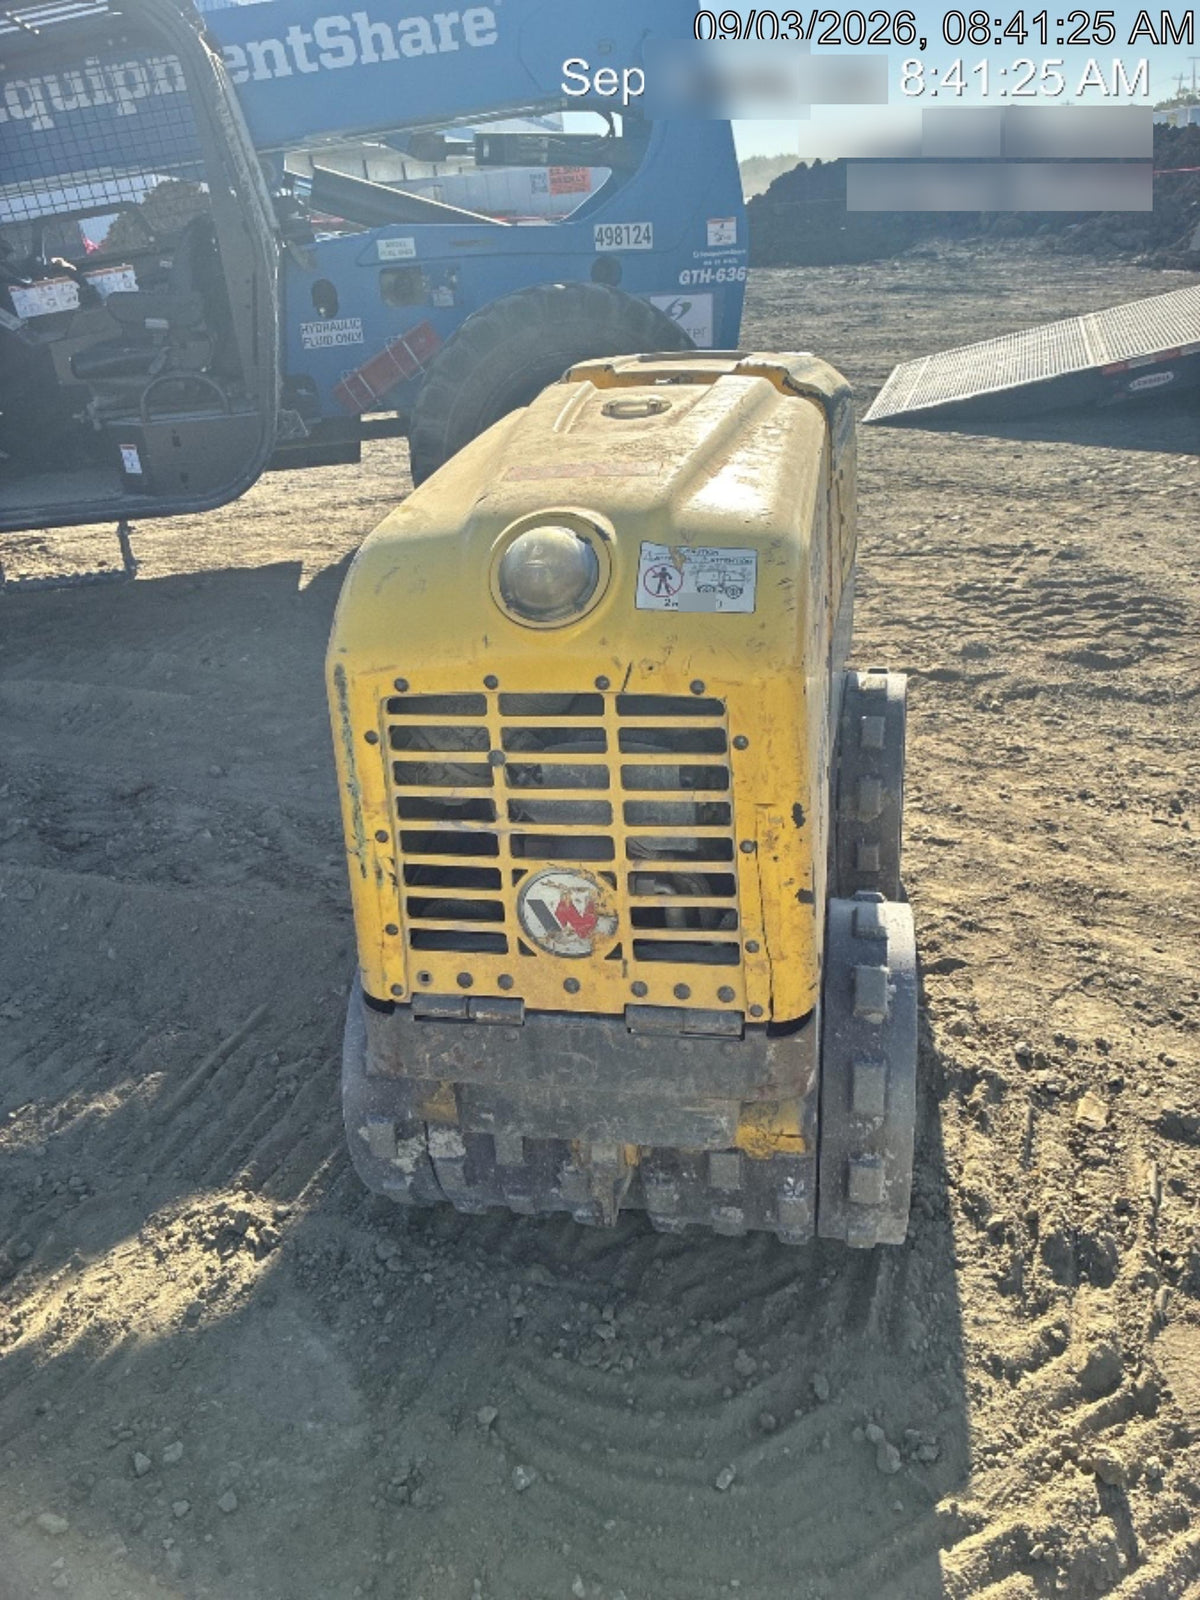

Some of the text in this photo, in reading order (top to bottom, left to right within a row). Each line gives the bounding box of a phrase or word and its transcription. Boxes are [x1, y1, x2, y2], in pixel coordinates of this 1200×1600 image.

[595, 226, 652, 247] 498124
[679, 266, 746, 286] GTH-636
[302, 319, 361, 334] HYDRAULIC
[303, 331, 362, 347] FLUID ONLY
